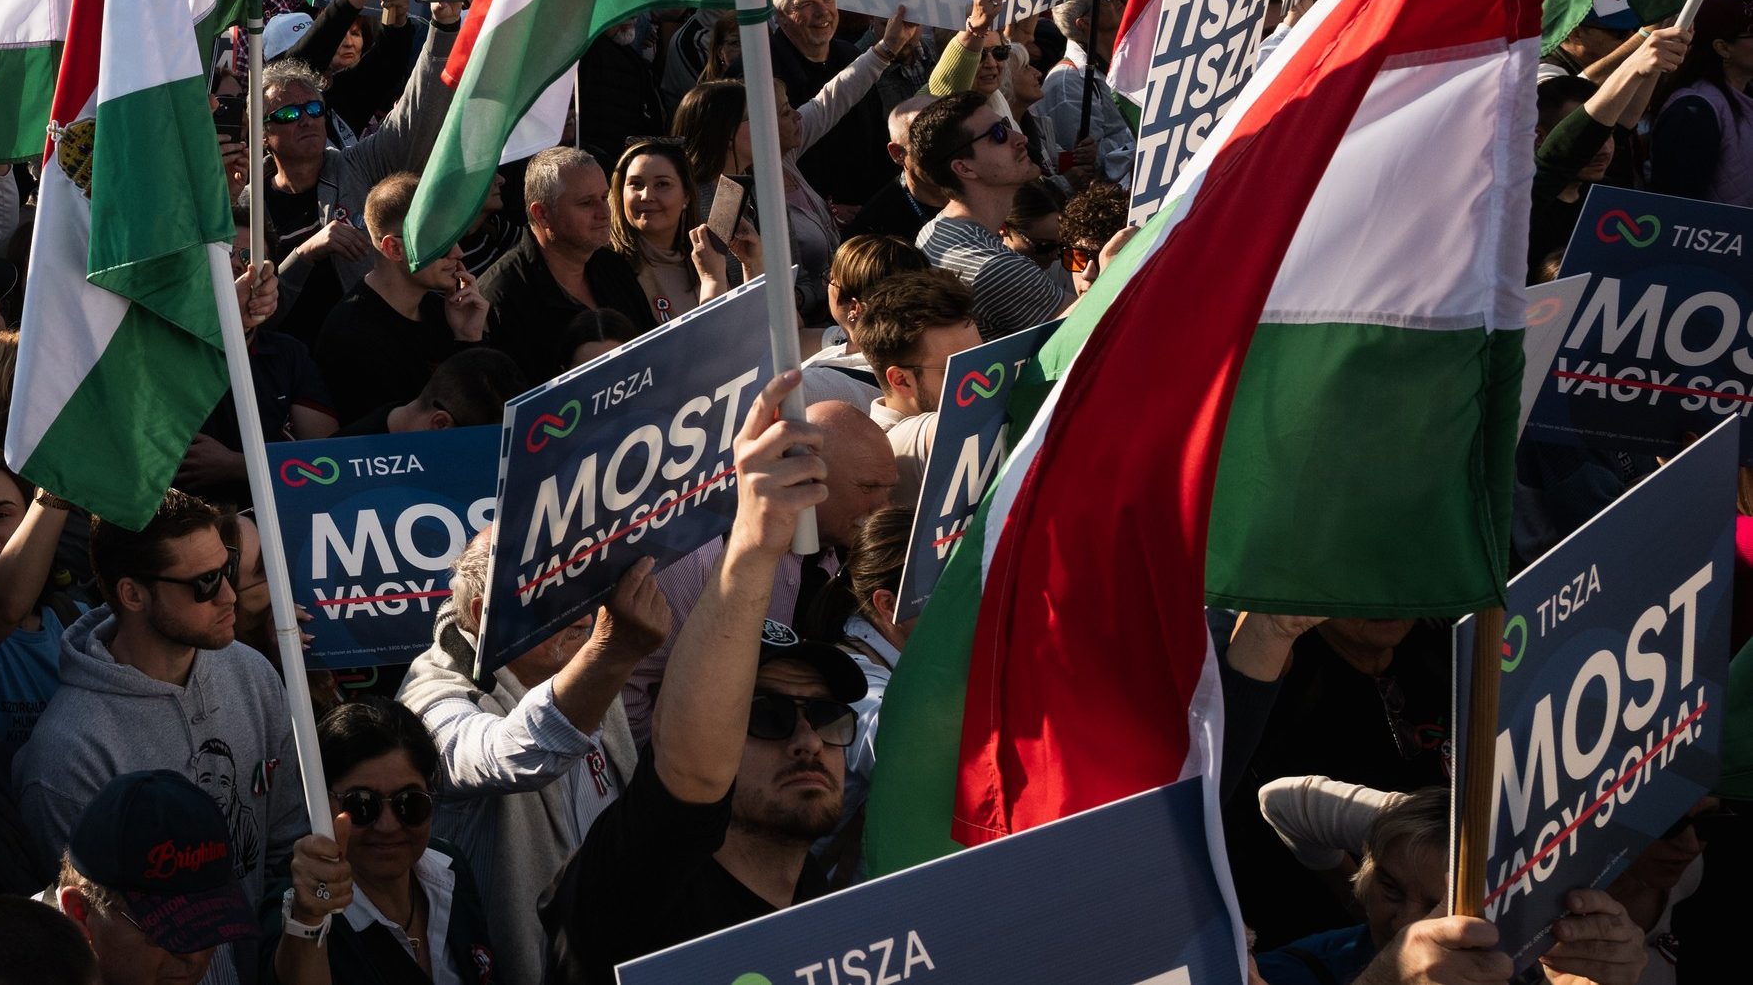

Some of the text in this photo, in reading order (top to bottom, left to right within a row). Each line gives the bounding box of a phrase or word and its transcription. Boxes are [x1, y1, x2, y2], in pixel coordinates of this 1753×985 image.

[1143, 17, 1265, 127] TISZA
[1672, 225, 1743, 256] TISZA
[1564, 277, 1753, 376] MO
[592, 367, 653, 415] TISZA
[1556, 357, 1681, 406] VAGY
[348, 454, 424, 477] TISZA
[520, 367, 760, 566] MOST
[311, 497, 496, 580] MO
[517, 519, 621, 607] VAGY
[313, 578, 435, 620] VAGY
[1537, 563, 1601, 638] TISZA
[1487, 561, 1713, 861] MOST
[1484, 791, 1587, 922] VAGY
[1595, 685, 1709, 829] SOHA!
[795, 930, 935, 985] TISZA
